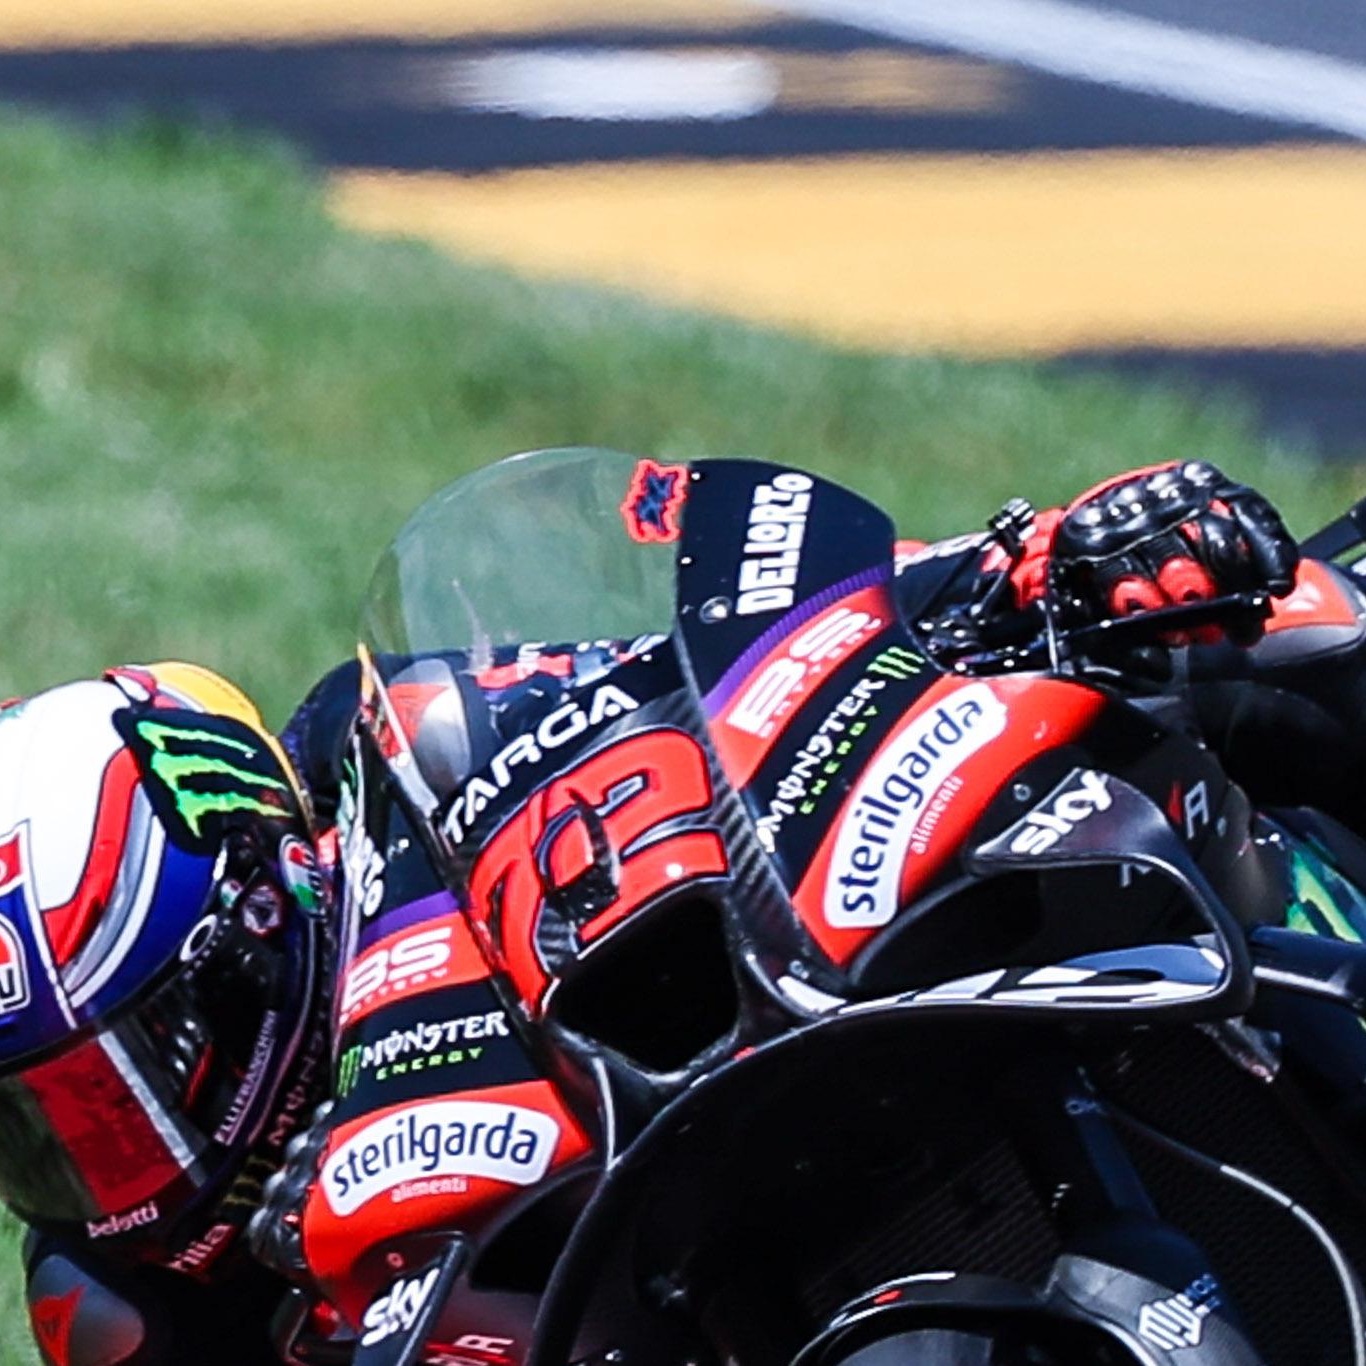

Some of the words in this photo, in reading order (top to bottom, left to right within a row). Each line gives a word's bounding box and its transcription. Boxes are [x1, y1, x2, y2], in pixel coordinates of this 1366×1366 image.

[441, 684, 639, 844] TARGA
[756, 678, 886, 853] MONSTER
[841, 699, 984, 914] sterilgarda
[910, 776, 964, 855] alimenti
[1011, 770, 1113, 856] sky
[341, 927, 452, 1012] BS
[361, 1011, 509, 1069] MONSTER
[333, 1112, 540, 1197] sterilgarda
[391, 1176, 467, 1203] alimenti
[361, 1268, 440, 1346] sky
